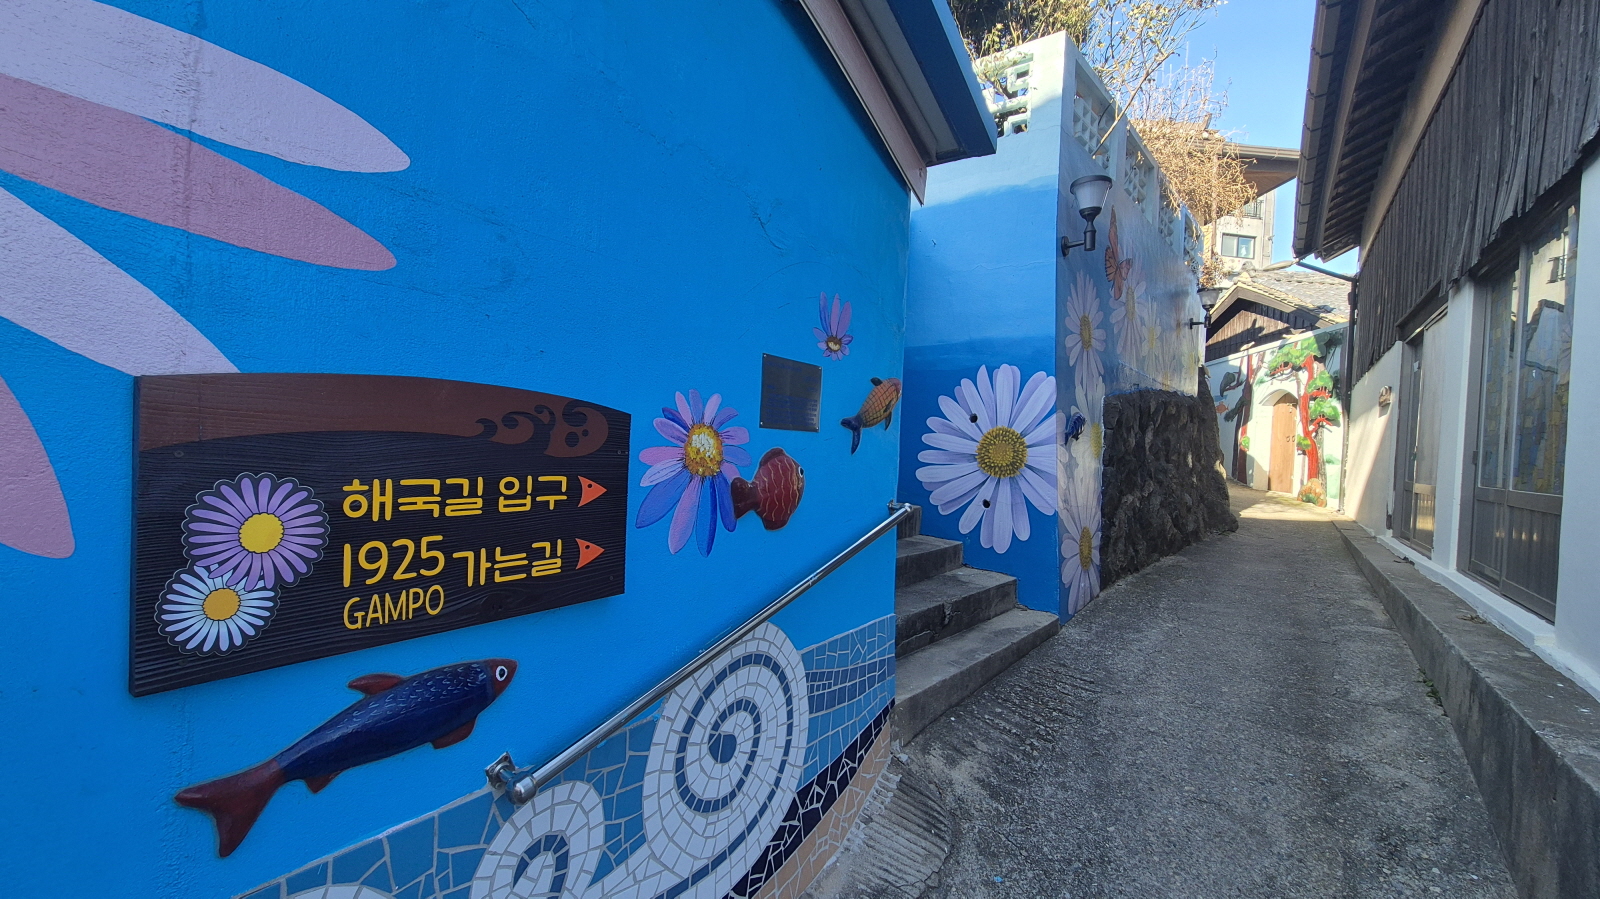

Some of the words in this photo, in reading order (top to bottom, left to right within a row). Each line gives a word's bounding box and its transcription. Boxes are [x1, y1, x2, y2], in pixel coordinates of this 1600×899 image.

[342, 476, 483, 522] 해국길
[498, 475, 568, 513] 입구
[342, 534, 446, 588] 1925
[452, 539, 563, 587] 가는길
[343, 584, 445, 630] GAMPO
